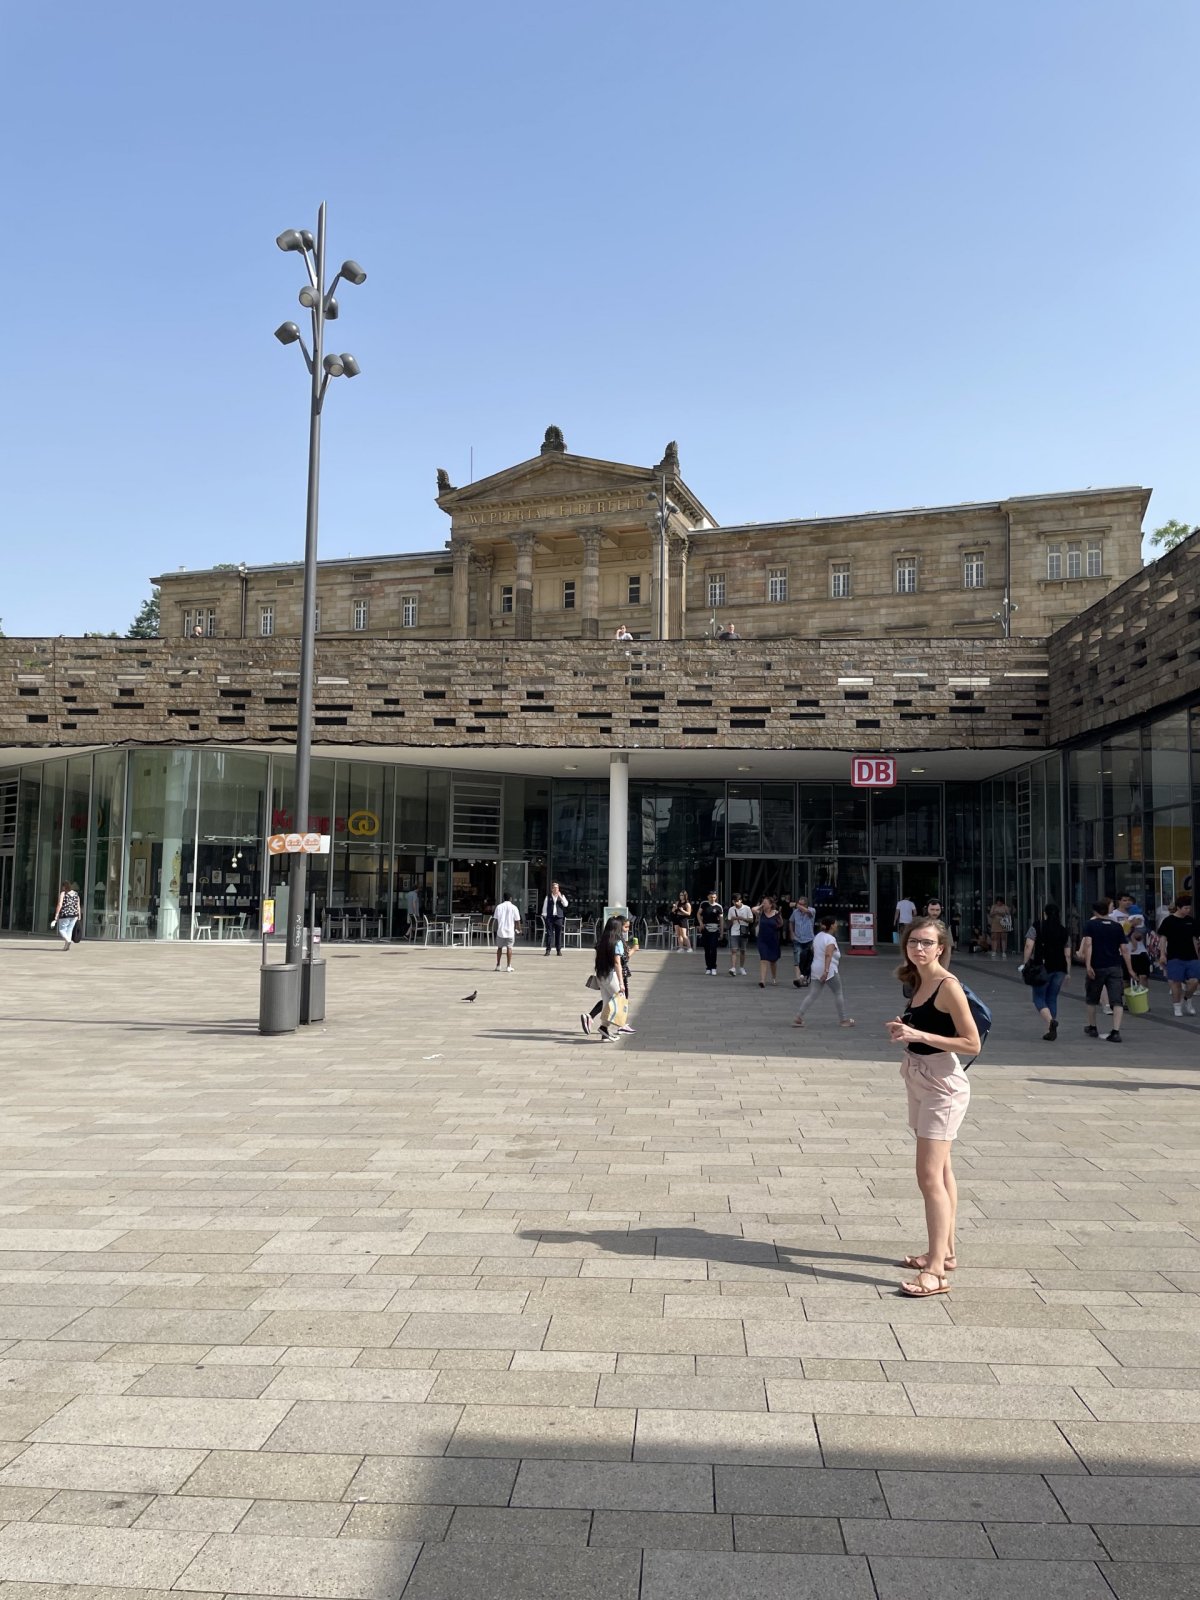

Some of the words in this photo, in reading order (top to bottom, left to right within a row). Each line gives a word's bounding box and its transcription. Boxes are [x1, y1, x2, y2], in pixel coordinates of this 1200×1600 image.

[469, 508, 550, 525] WUPPERTAL
[560, 498, 643, 516] ELBERFELD
[857, 761, 891, 782] DB
